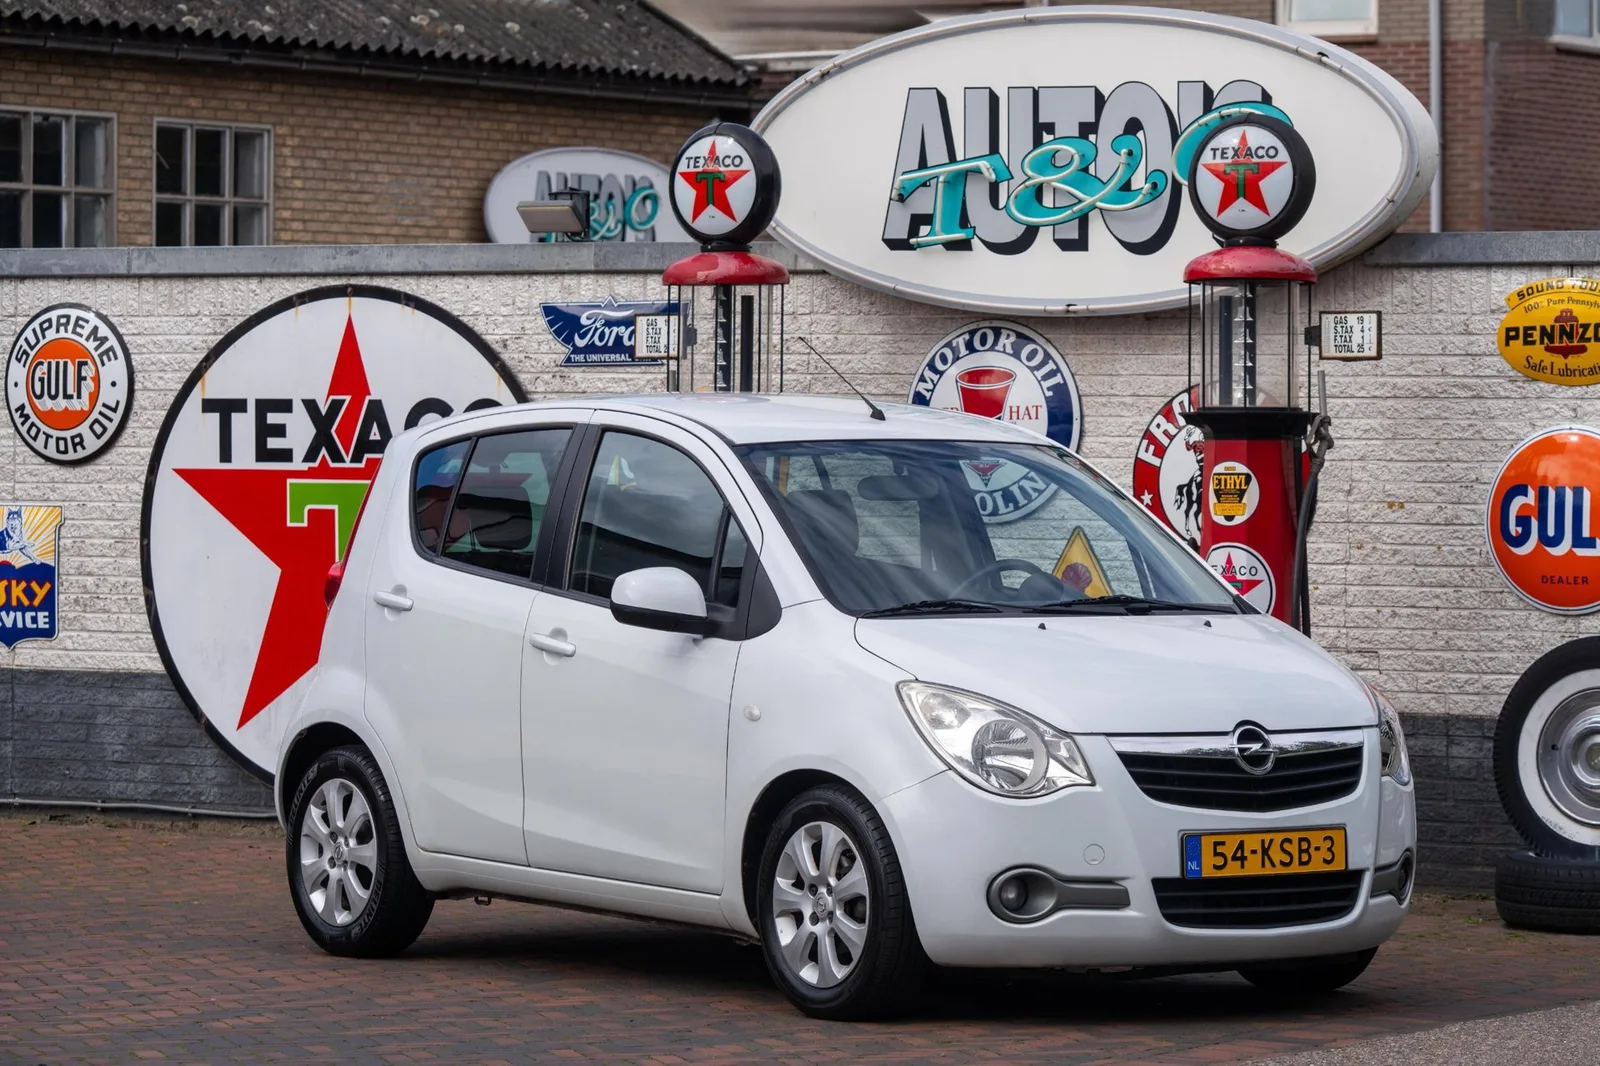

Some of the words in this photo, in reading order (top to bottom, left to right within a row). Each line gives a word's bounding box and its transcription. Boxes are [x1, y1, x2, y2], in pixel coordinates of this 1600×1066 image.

[1210, 145, 1279, 160] TEXACO
[685, 154, 744, 169] TEXACO
[1516, 280, 1565, 301] SOUND
[1569, 279, 1600, 293] YOU
[1546, 298, 1566, 307] Pure
[645, 318, 658, 327] GAS
[1333, 315, 1349, 325] GAS
[1356, 315, 1365, 325] 19
[1333, 325, 1354, 335] S.TAX
[1360, 325, 1365, 335] 4
[14, 313, 119, 369] SUPREME
[1333, 335, 1353, 344] F.TAX
[1361, 335, 1365, 344] 1
[645, 344, 662, 354] TOTAL
[1333, 344, 1355, 354] TOTAL
[1356, 344, 1365, 354] 25
[570, 354, 586, 363] THE
[586, 353, 632, 362] UNIVERSAL
[915, 327, 1018, 401] MOTOR
[1019, 342, 1066, 398] OIL
[1523, 354, 1549, 374] Safe
[31, 359, 93, 408] GULF
[1008, 404, 1043, 421] HAT
[14, 402, 87, 455] MOTOR
[89, 400, 121, 441] OIL
[201, 396, 503, 465] TEXA
[1213, 474, 1248, 490] ETHYL
[1540, 575, 1590, 586] DEALER
[0, 610, 50, 629] VICE
[1212, 835, 1336, 871] 54-KSB-3
[1187, 860, 1200, 870] NL
